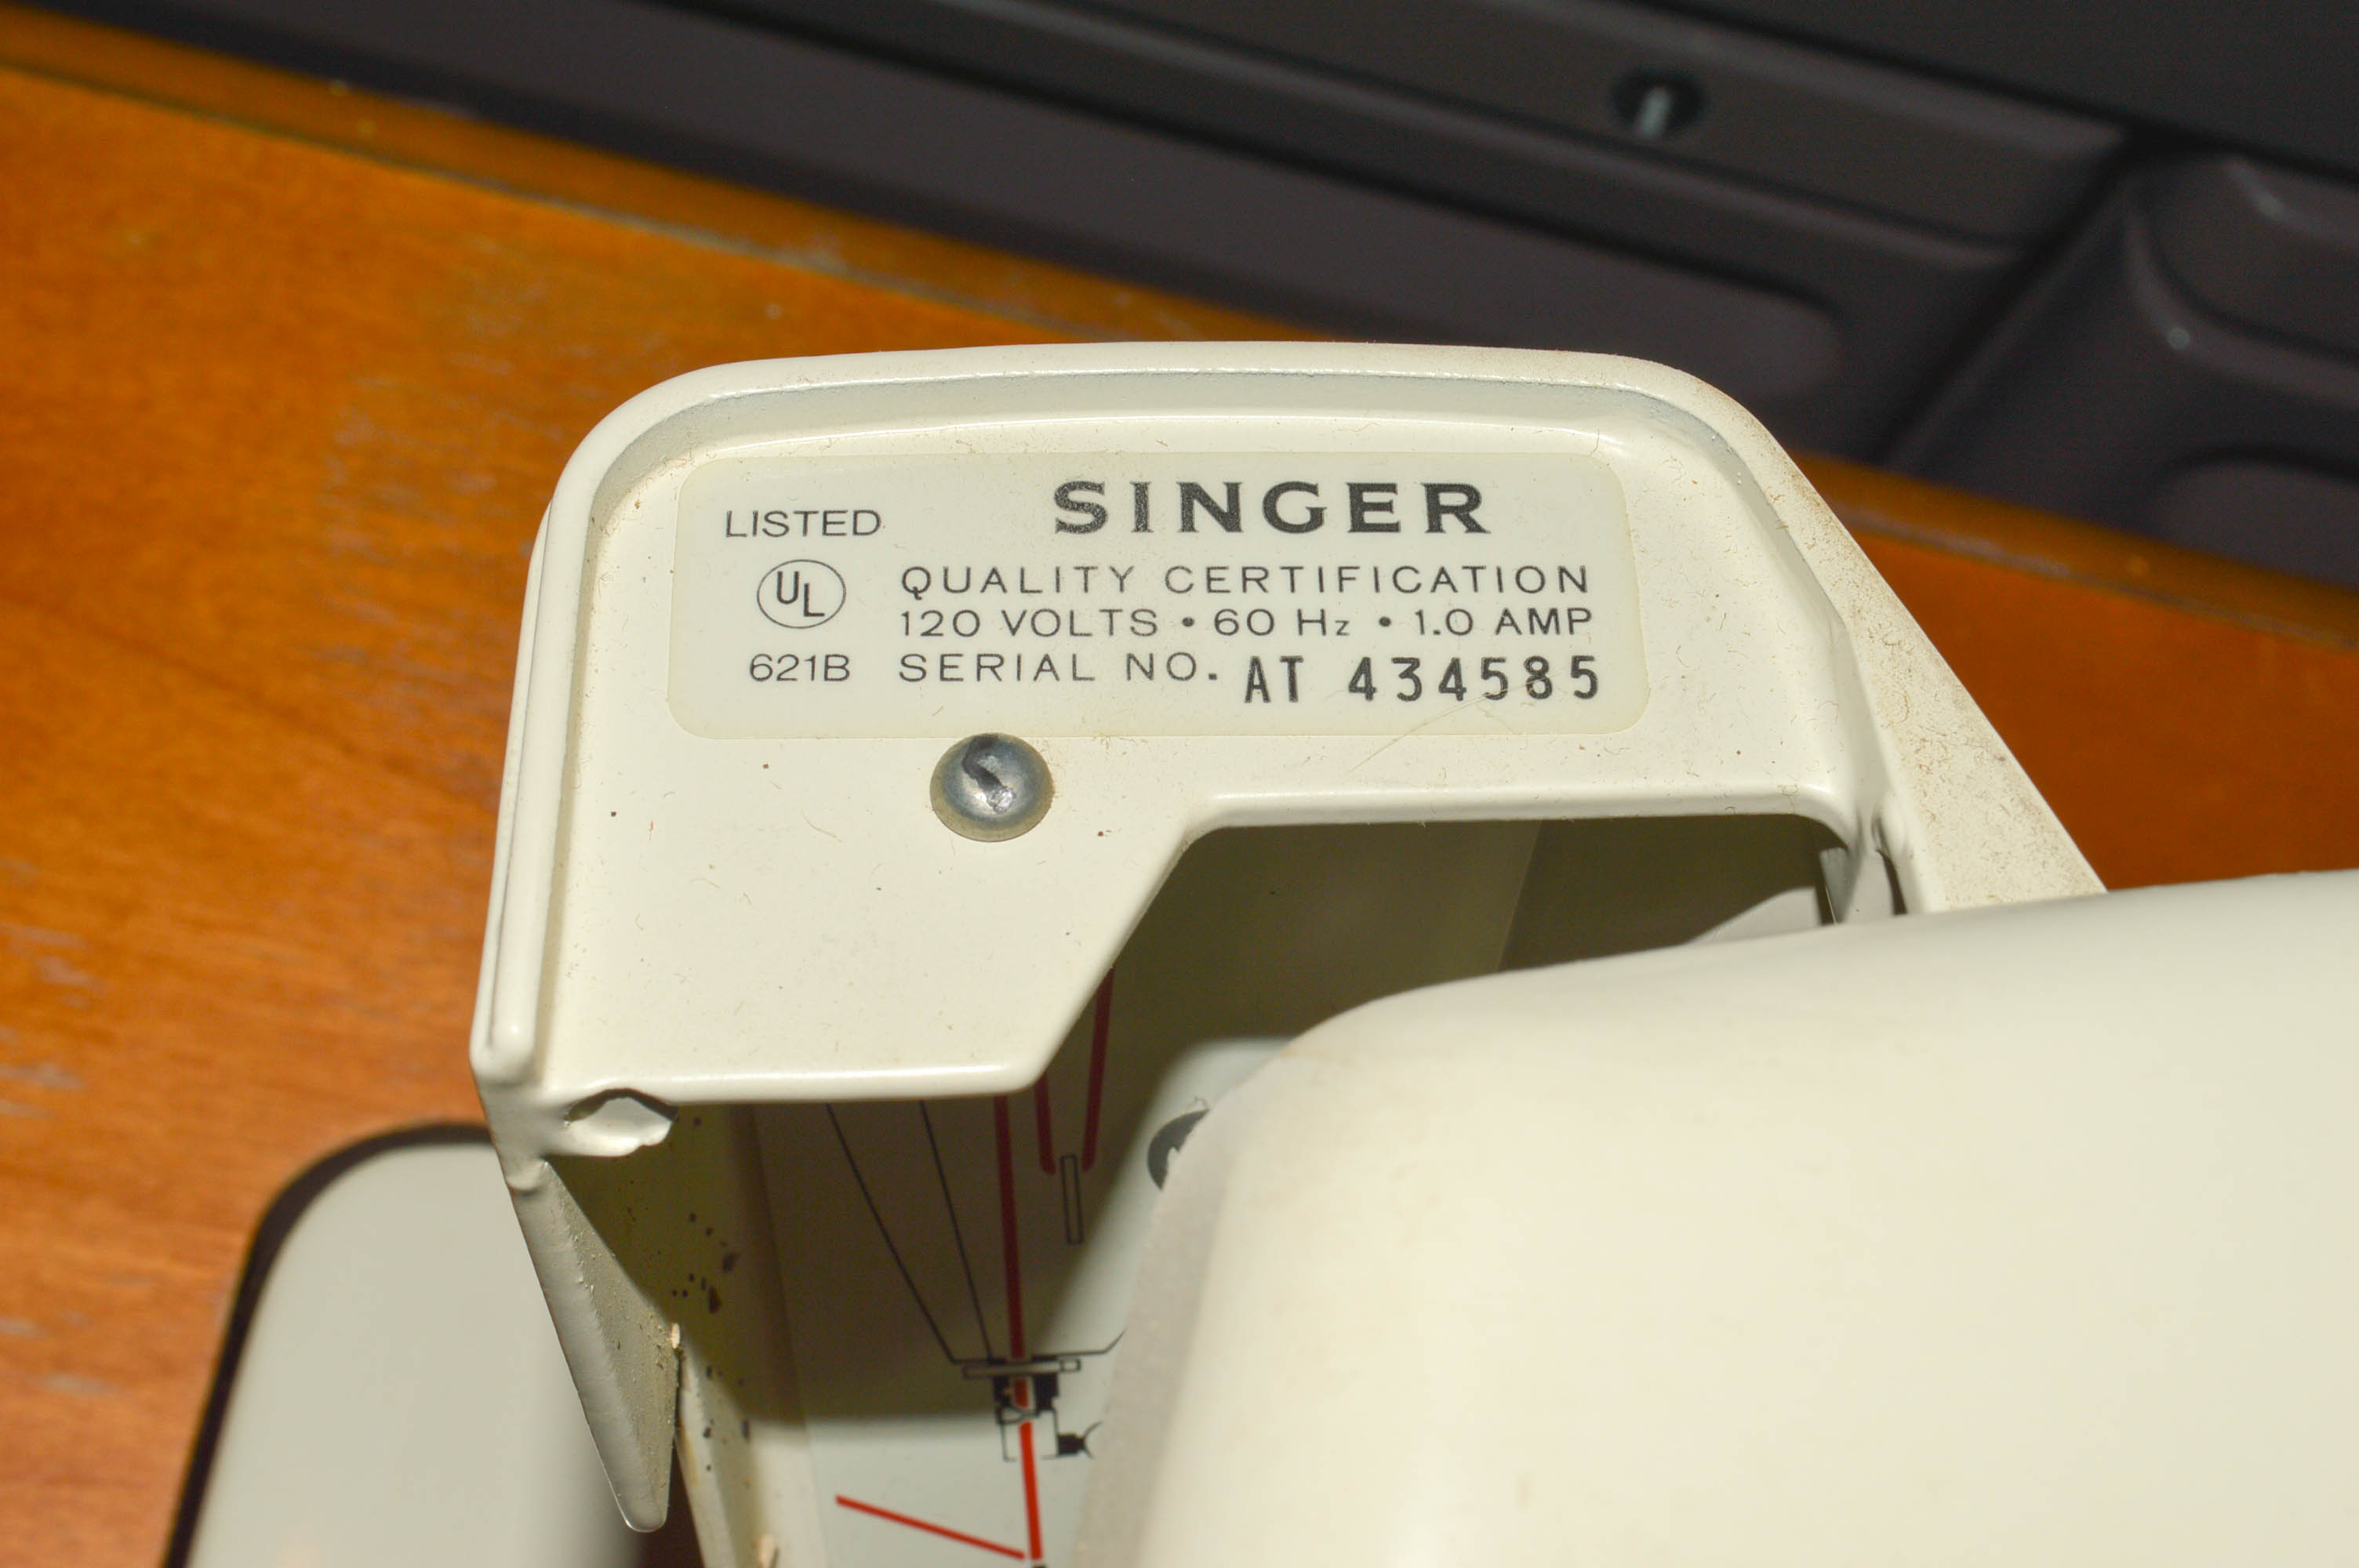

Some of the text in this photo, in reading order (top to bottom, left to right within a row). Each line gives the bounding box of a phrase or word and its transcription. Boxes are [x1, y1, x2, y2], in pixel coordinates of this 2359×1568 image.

[725, 509, 882, 538] LISTED
[1053, 481, 1488, 535] SINGER
[776, 569, 826, 618] UL
[901, 565, 1588, 601] QUALITY CERTIFICATION
[901, 607, 1592, 637] 120 VOLTS 60 Hz 1.0 AMP
[749, 653, 850, 682] 621B
[899, 652, 1598, 703] SERIAL NO. AT 434585
